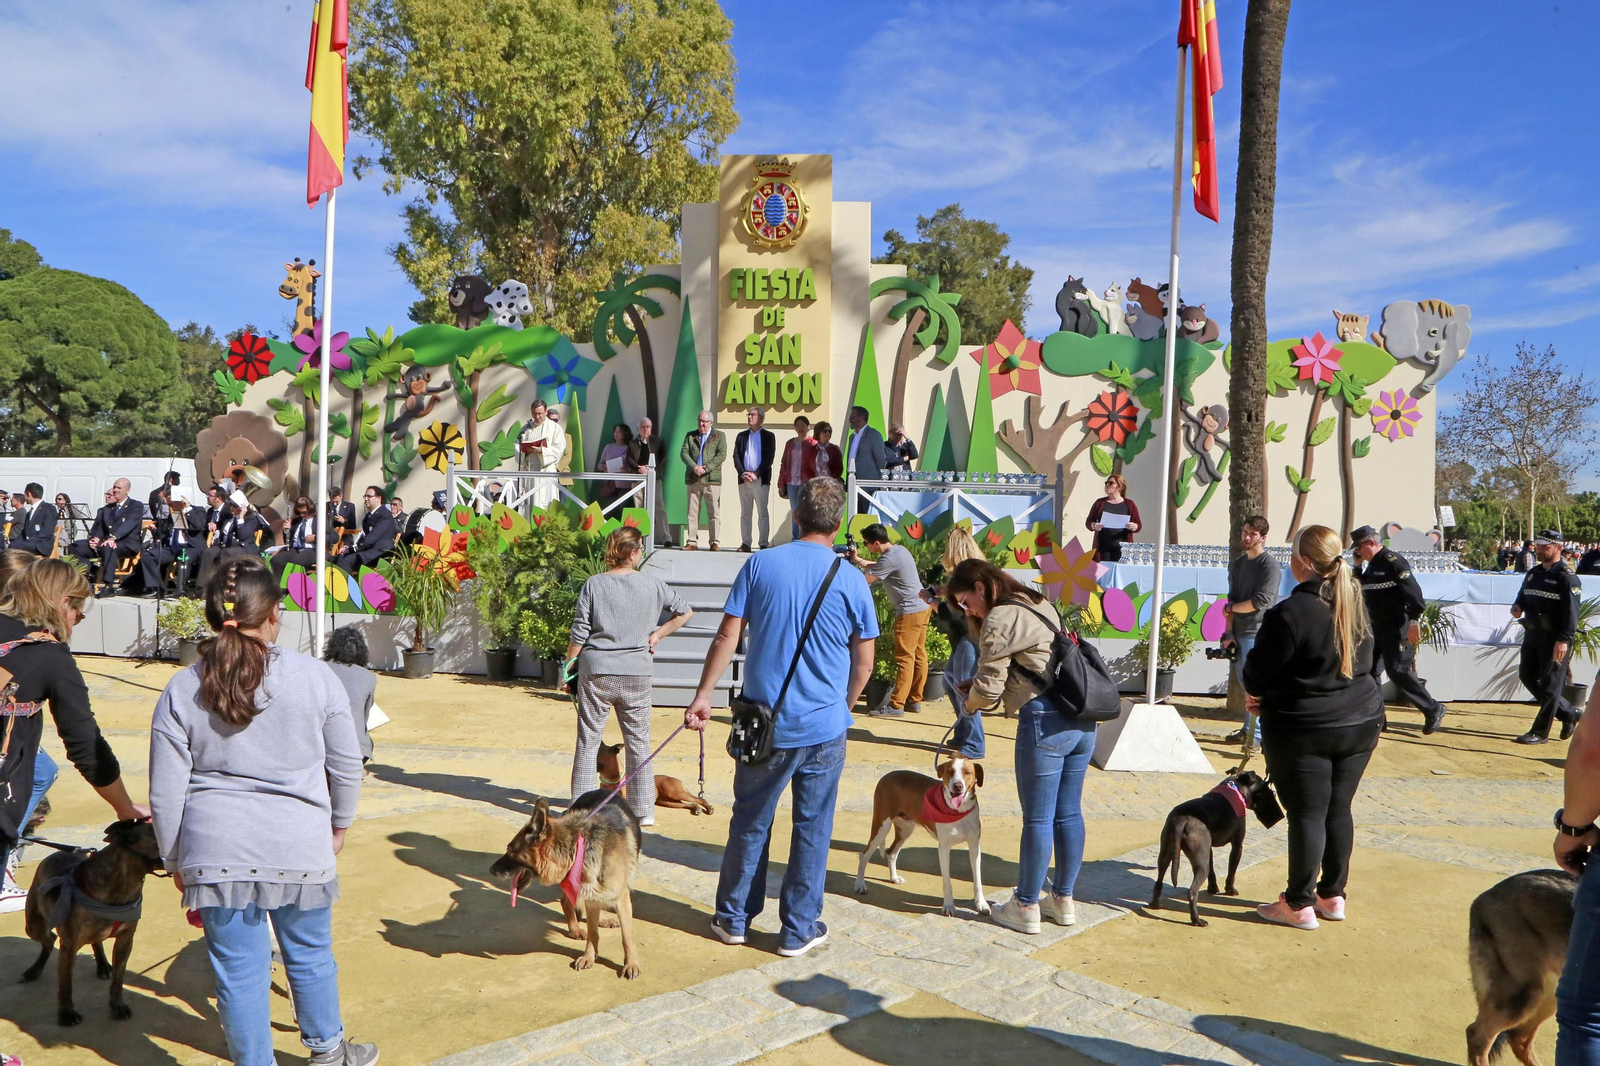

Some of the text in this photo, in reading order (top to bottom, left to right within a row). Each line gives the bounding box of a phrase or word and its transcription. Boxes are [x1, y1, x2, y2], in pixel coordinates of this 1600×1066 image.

[731, 268, 817, 300] FIESTA
[763, 307, 785, 327] DE
[745, 333, 801, 366] SAN
[724, 372, 822, 405] ANTON
